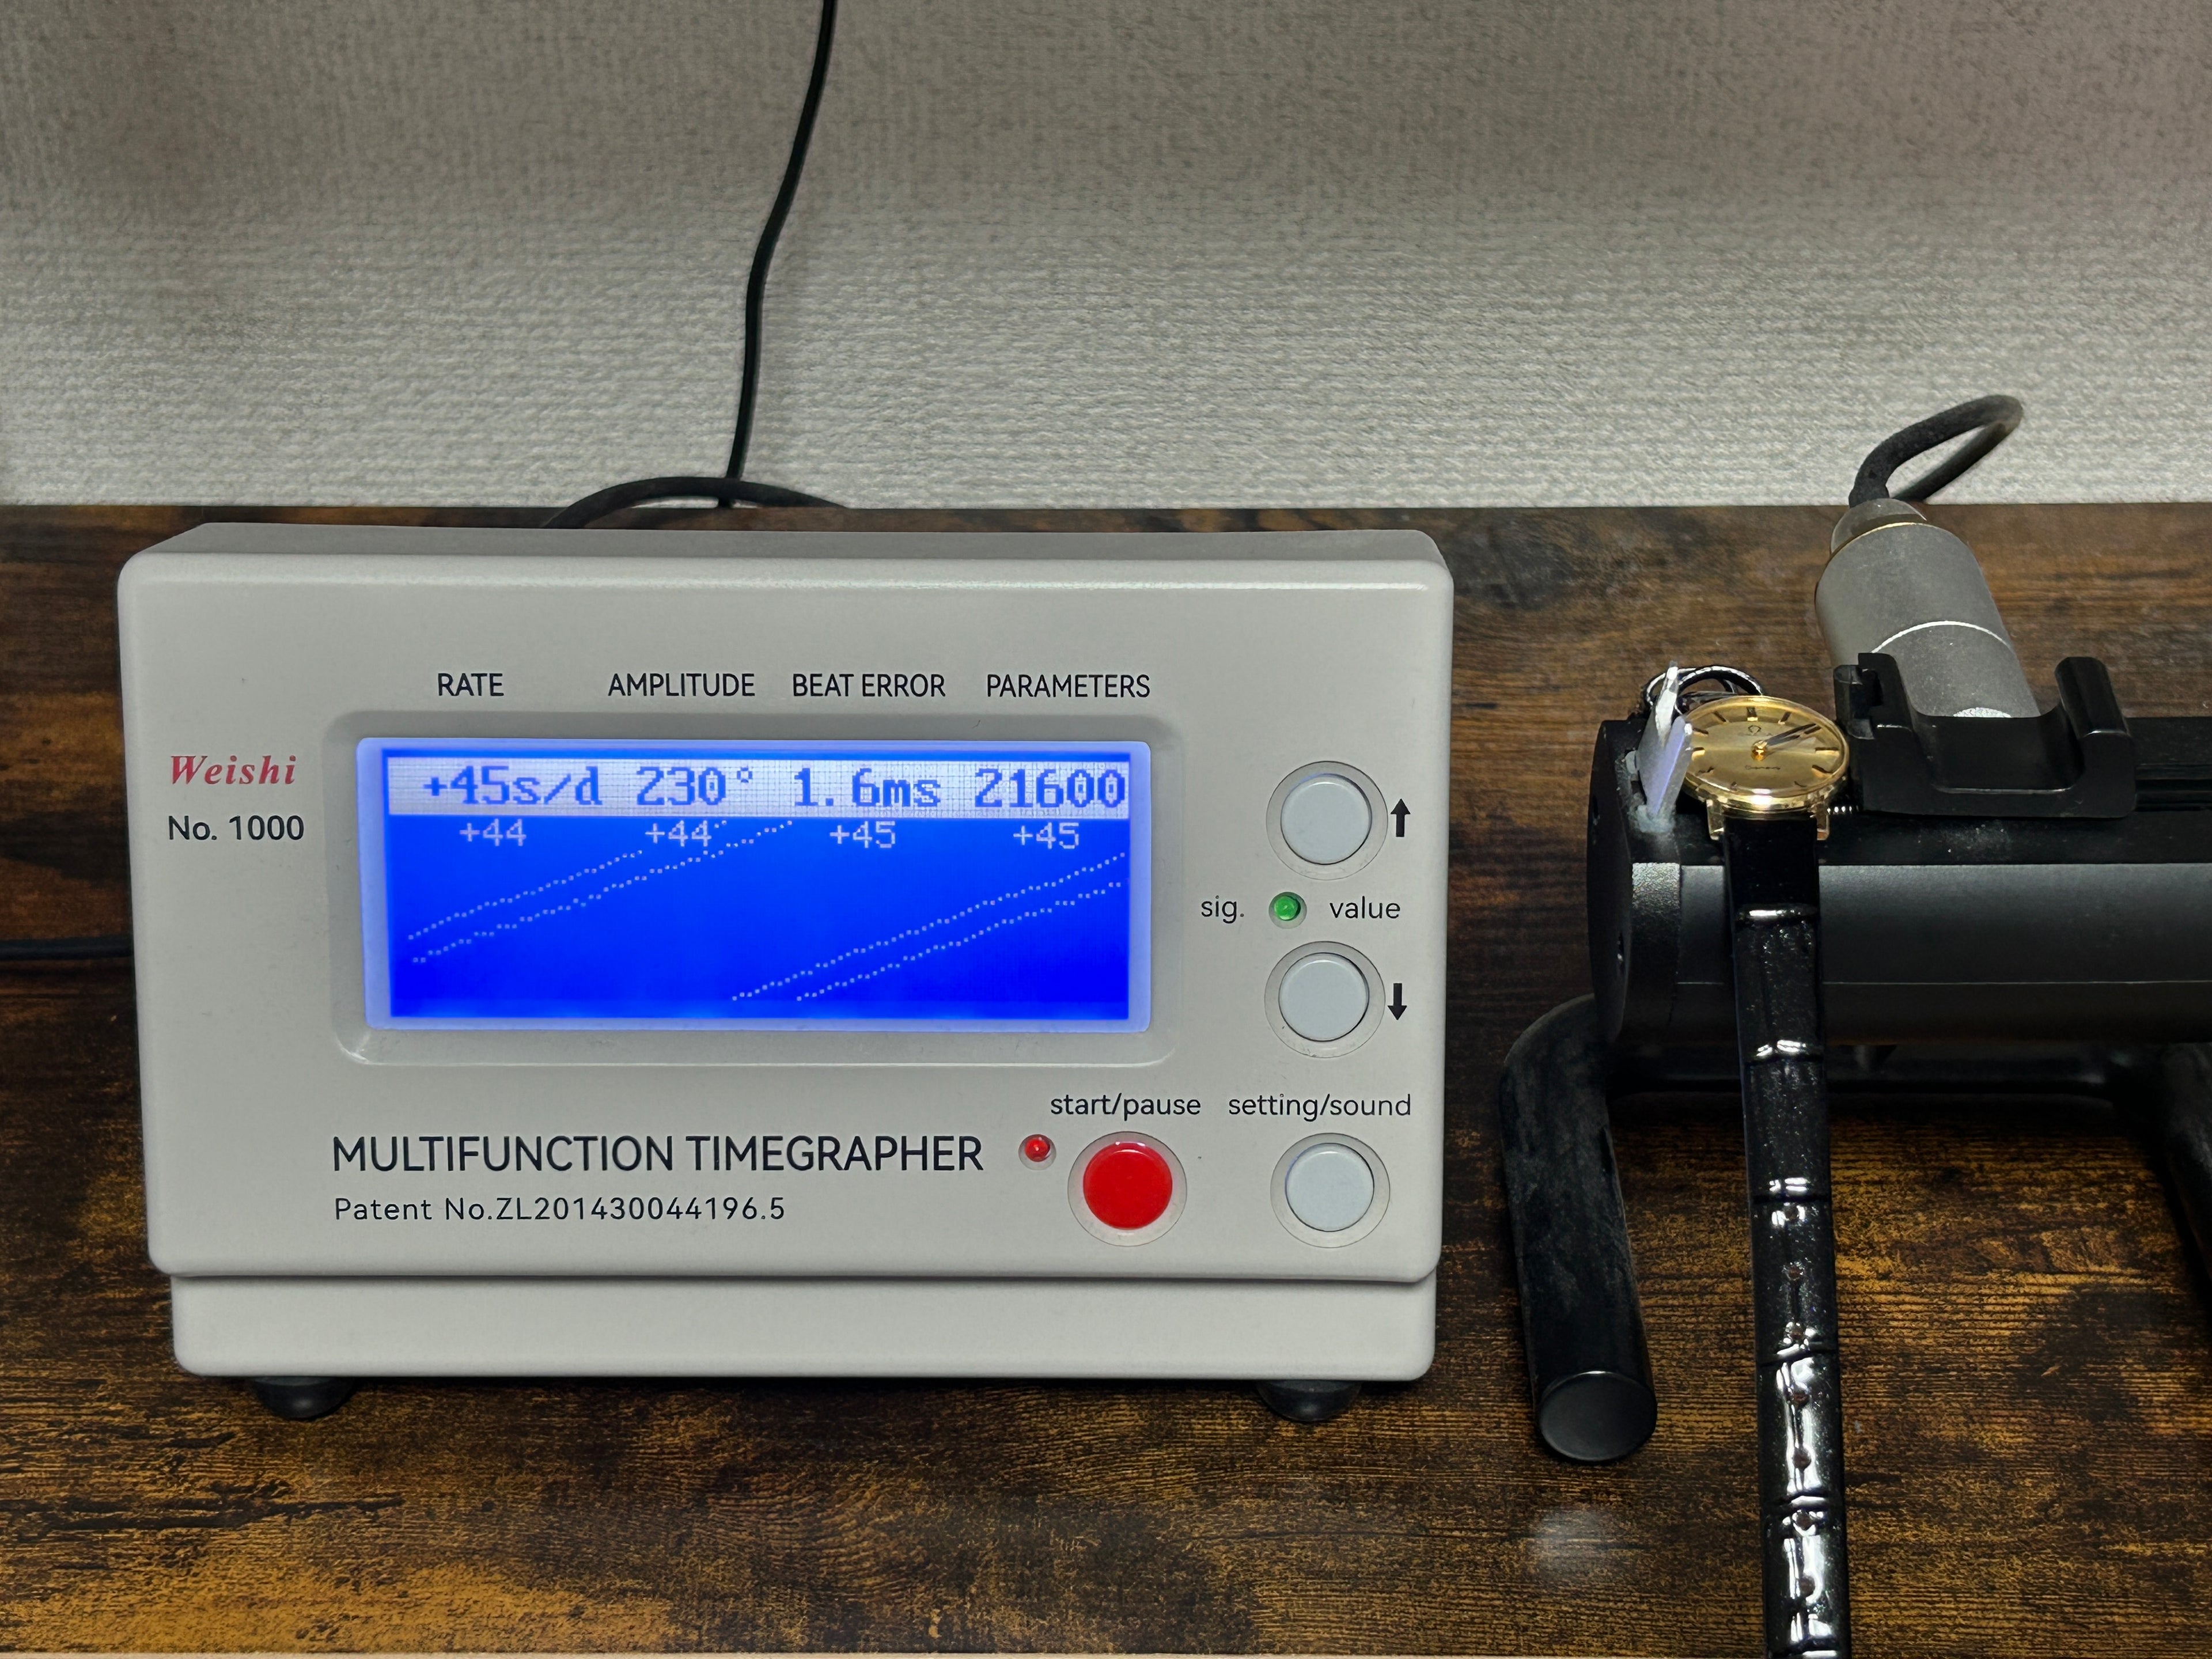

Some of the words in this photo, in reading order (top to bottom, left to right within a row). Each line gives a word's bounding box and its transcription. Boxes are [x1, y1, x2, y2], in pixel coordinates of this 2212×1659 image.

[437, 672, 505, 697] RATE
[608, 672, 755, 697] AMPLITUDE
[793, 673, 855, 697] BEAT
[862, 673, 946, 698] ERROR
[987, 673, 1150, 698] PARAMETERS
[171, 755, 297, 785] Weishi
[424, 766, 603, 805] +45s/d
[794, 768, 941, 808] 1.6ms
[975, 768, 1125, 808] 21600
[168, 815, 217, 840] No.
[229, 815, 304, 840] 1000
[460, 818, 527, 846] +44
[645, 819, 712, 847] +44
[830, 820, 896, 849] +45
[1013, 821, 1079, 849] +45
[1201, 895, 1244, 924] sig.
[1329, 895, 1401, 919] value
[1050, 1092, 1201, 1122] start/pause
[1228, 1093, 1411, 1122] setting/sound
[333, 1135, 673, 1172] MULTIFUNCTION
[685, 1135, 984, 1172] TIMEGRAPHER
[335, 1198, 433, 1220] Patent
[445, 1196, 785, 1221] No.ZL201430044196.5
